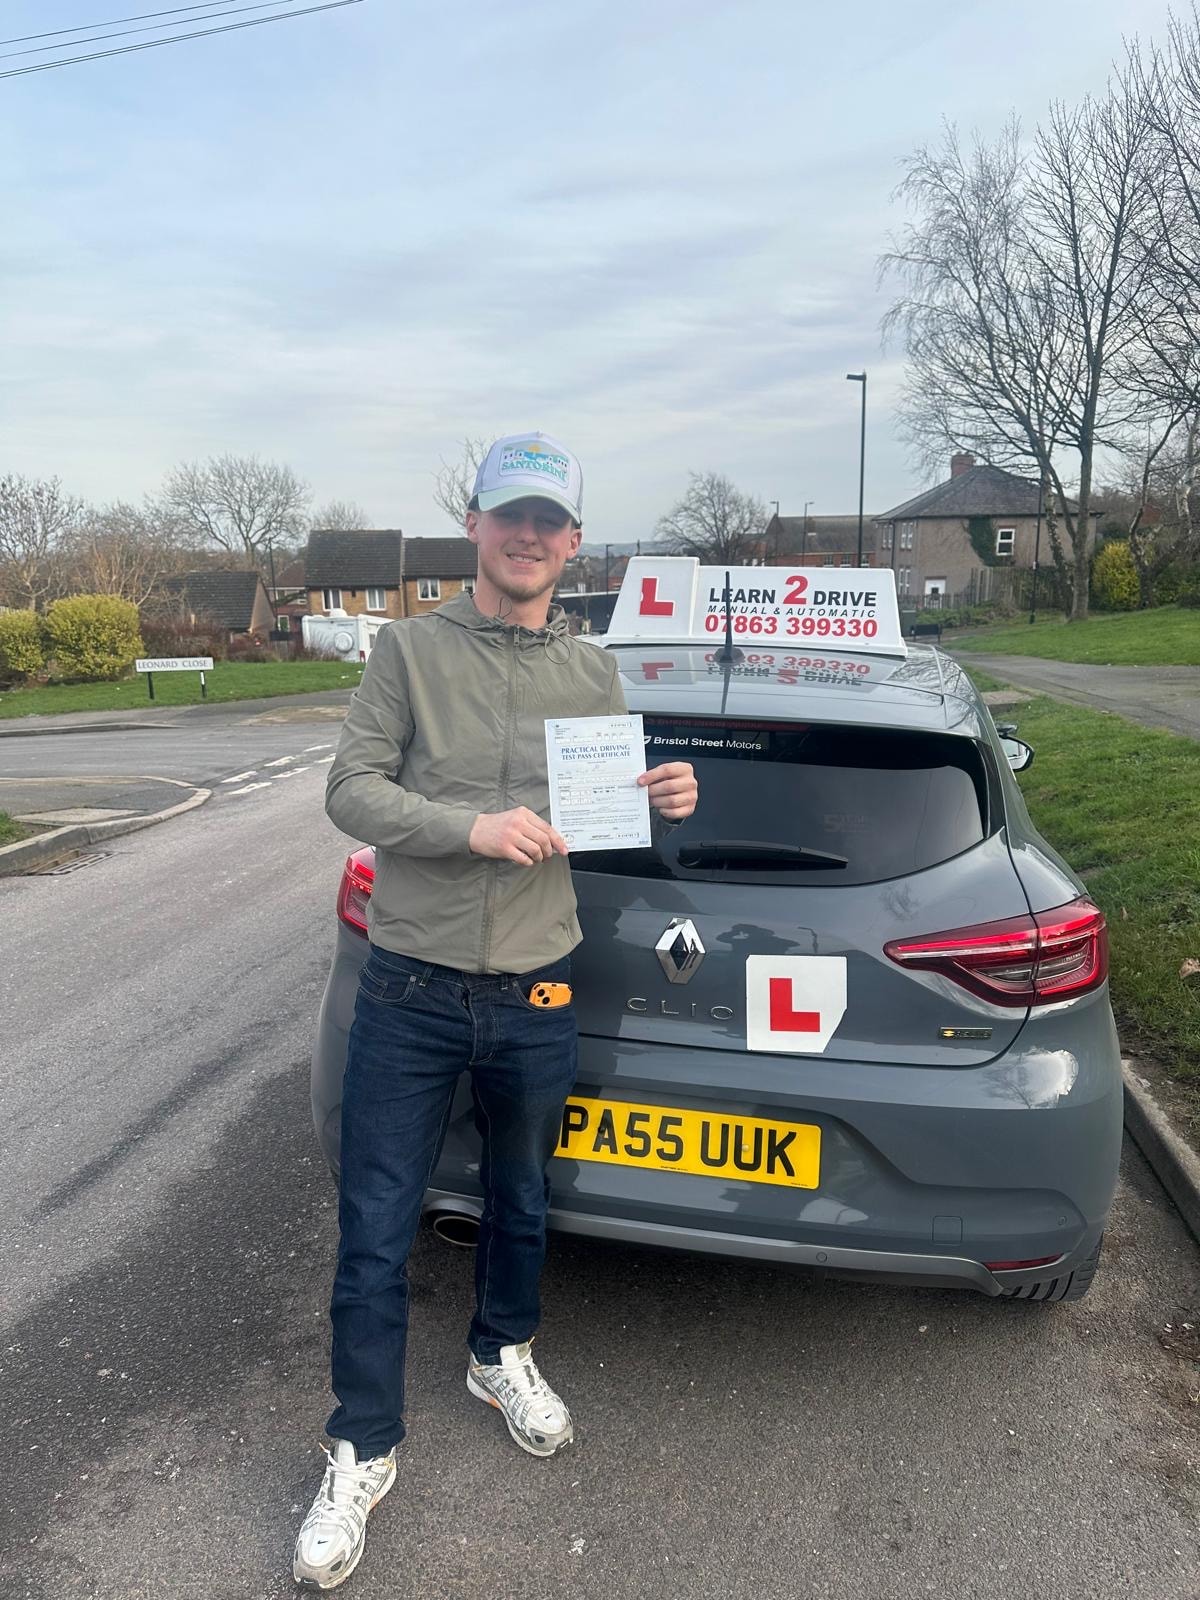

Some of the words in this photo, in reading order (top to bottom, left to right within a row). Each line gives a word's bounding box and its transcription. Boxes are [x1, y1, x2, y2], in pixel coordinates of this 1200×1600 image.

[501, 460, 567, 481] SANTORINI
[639, 577, 674, 616] L
[709, 588, 776, 604] LEARN
[783, 575, 809, 605] 2
[813, 590, 877, 607] DRIVE
[707, 605, 768, 615] MANUAL
[786, 607, 876, 618] AUTOMATIC
[705, 614, 778, 634] 07863
[786, 617, 878, 638] 399330
[138, 660, 178, 669] LEONARD
[182, 659, 207, 668] CLOSE
[561, 746, 598, 754] PRACTICAL
[600, 744, 631, 752] DRIVING
[653, 737, 689, 746] Bristol
[691, 737, 724, 747] Street
[725, 741, 762, 750] Motors
[593, 751, 631, 759] CERTIFICATE
[626, 997, 734, 1020] CLIO
[769, 978, 821, 1032] L
[560, 1104, 684, 1162] PA55
[700, 1121, 797, 1177] UUK
